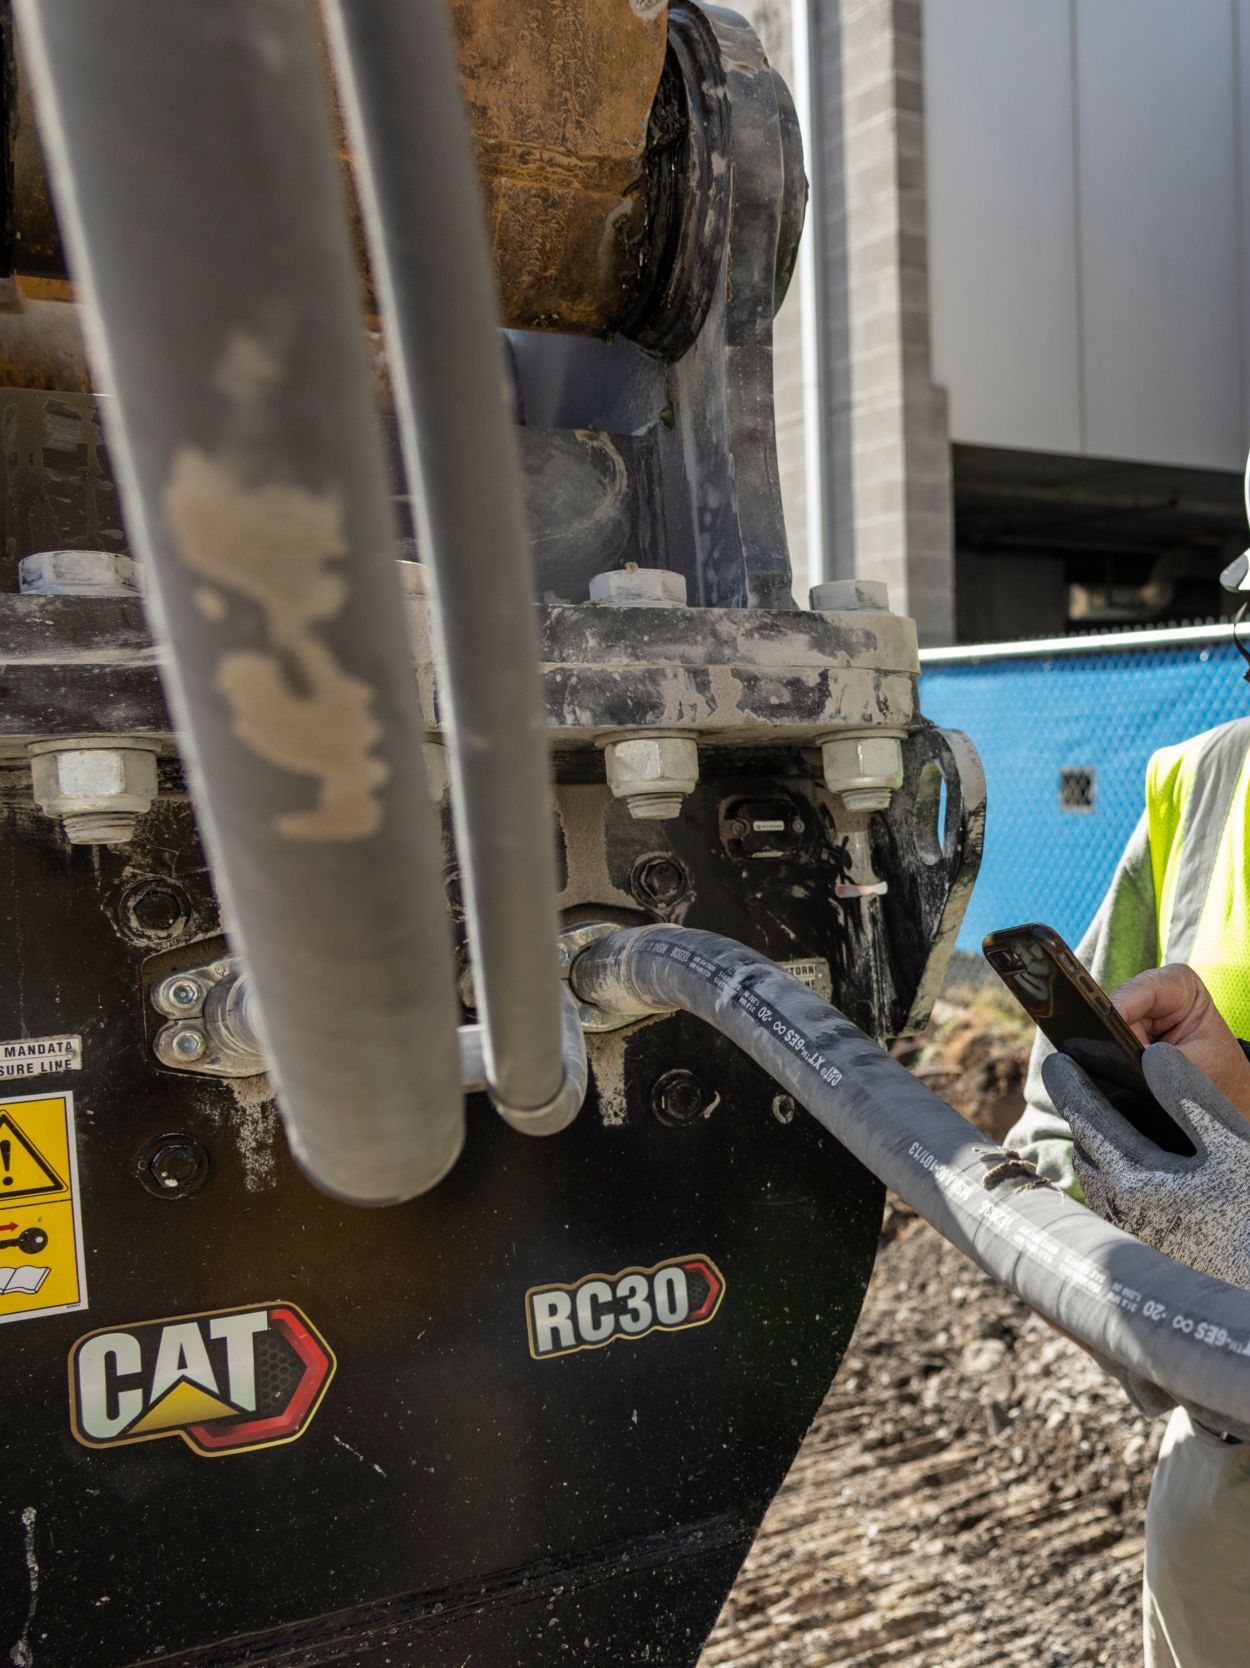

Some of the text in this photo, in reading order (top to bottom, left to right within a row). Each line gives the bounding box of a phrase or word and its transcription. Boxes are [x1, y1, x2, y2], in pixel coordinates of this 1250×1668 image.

[4, 1041, 72, 1058] MANDATA
[41, 1060, 72, 1073] LINE
[533, 1267, 689, 1352] RC30
[79, 1311, 268, 1438] CAT
